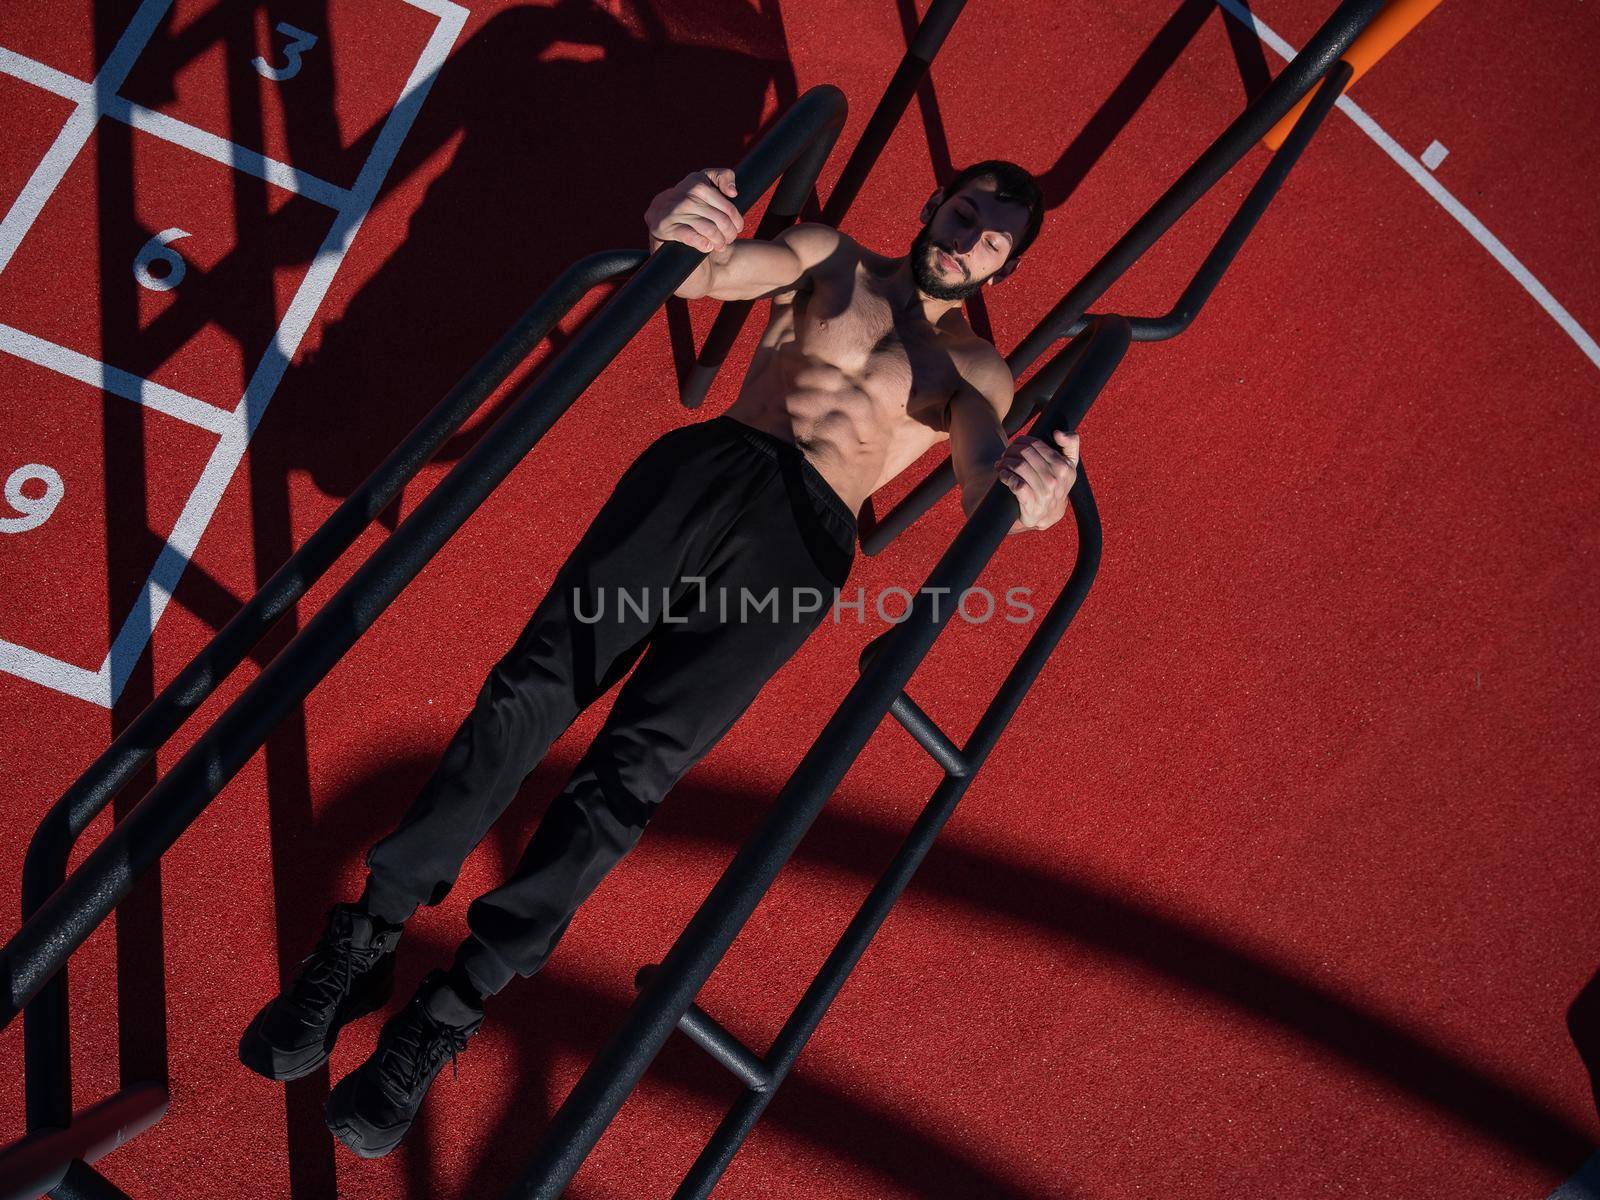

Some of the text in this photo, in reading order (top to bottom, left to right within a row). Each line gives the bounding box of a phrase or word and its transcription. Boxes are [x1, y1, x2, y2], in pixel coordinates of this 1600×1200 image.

[251, 22, 319, 81] 3
[133, 226, 192, 292] 6
[0, 463, 65, 534] 9
